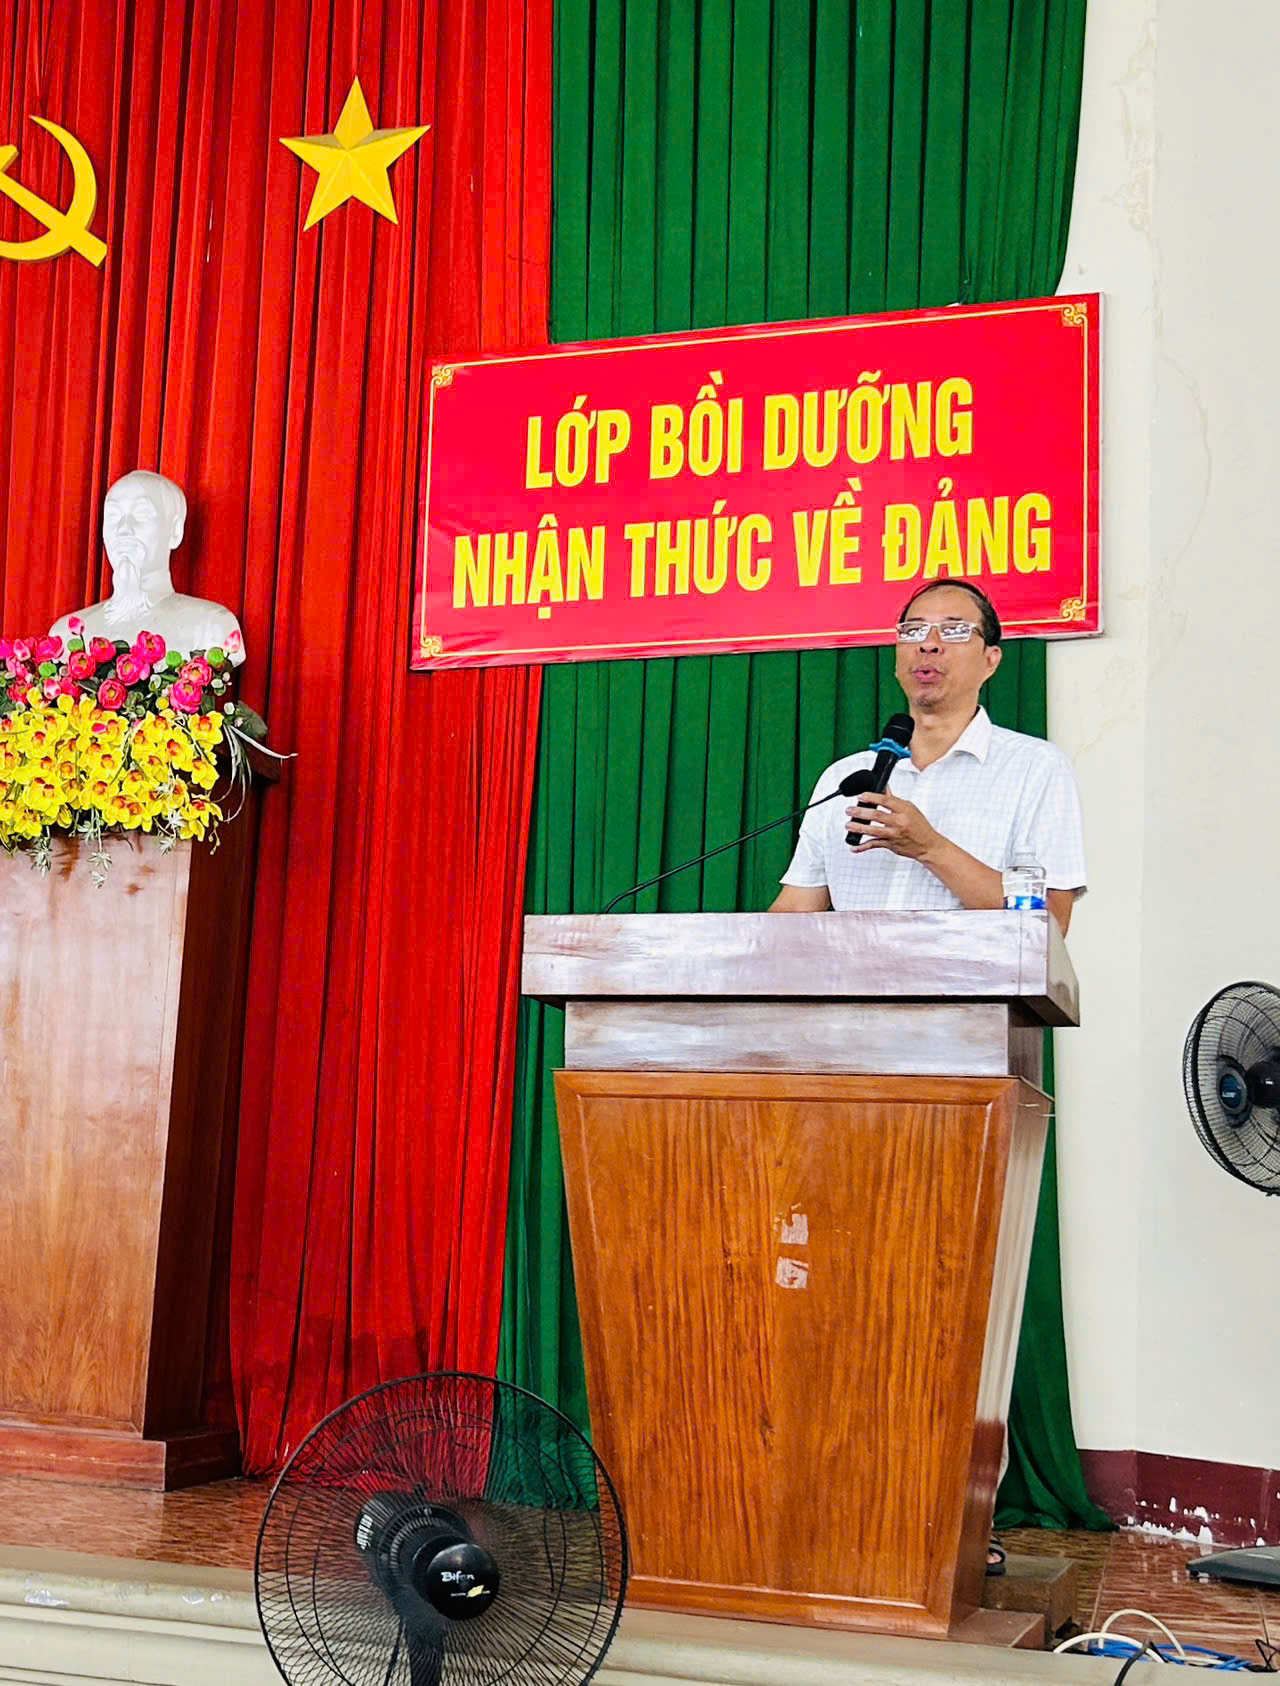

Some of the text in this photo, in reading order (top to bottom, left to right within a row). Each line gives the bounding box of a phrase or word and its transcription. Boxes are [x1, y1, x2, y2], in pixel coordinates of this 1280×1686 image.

[525, 370, 973, 489] LỚP BỒI DƯỠNG
[453, 477, 1053, 620] NHẬN THỨC VỀ ĐẢNG
